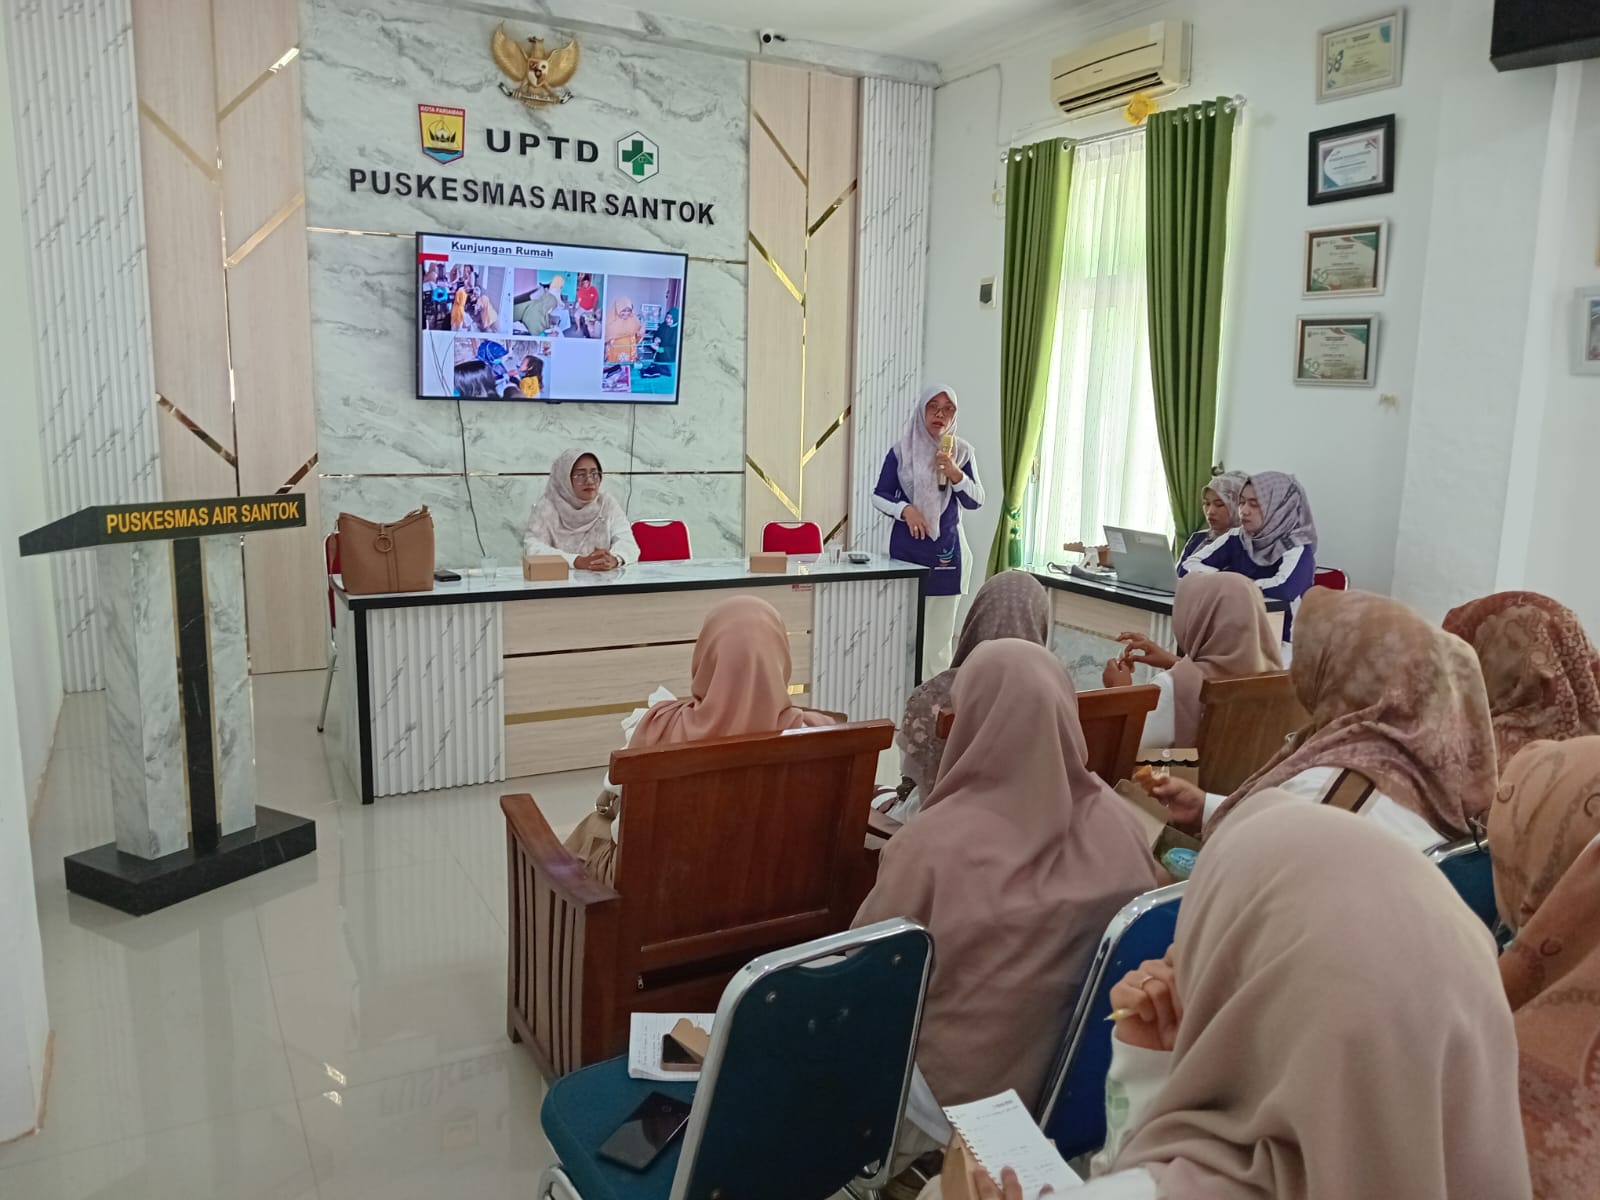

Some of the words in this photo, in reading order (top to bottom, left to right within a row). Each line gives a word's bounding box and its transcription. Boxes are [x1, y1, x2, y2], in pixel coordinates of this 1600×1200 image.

[485, 128, 599, 163] UPTD
[349, 168, 545, 209] PUSKESMAS
[551, 187, 597, 213] AIR
[604, 194, 715, 225] SANTOK
[451, 241, 512, 256] Kunjungan
[515, 246, 554, 258] Rumah
[106, 507, 209, 534] PUSKESMAS
[212, 505, 238, 525] AIR
[240, 501, 299, 523] SANTOK
